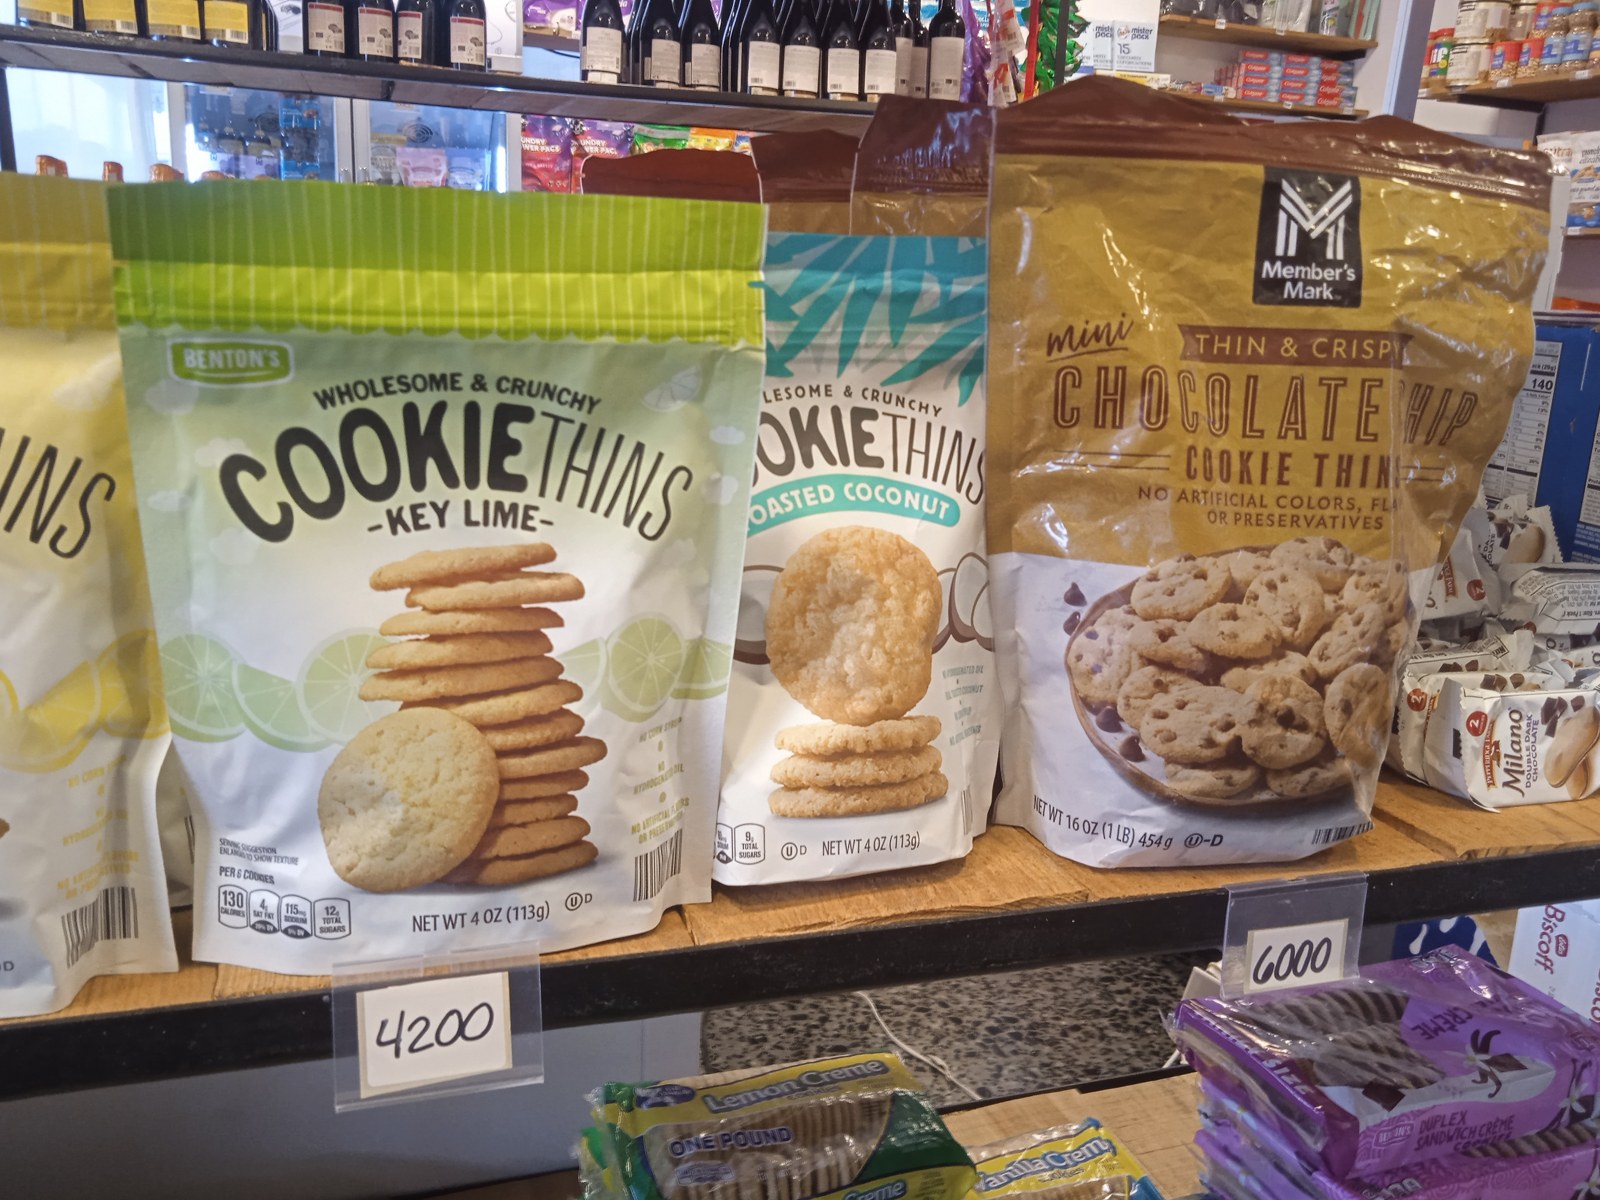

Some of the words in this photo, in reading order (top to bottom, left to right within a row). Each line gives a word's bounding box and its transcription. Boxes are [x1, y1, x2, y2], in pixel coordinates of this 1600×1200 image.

[1131, 26, 1153, 35] mister
[1118, 44, 1130, 54] 15
[1262, 260, 1356, 281] Member's
[1283, 281, 1333, 300] Mark
[1046, 312, 1134, 357] mini
[1196, 333, 1266, 356] THIN
[1281, 336, 1299, 358] &
[184, 347, 280, 369] BENTON'S
[313, 372, 463, 411] WHOLESOME
[471, 373, 488, 393] &
[495, 373, 602, 416] CRUNCHY
[1532, 378, 1554, 391] 140
[843, 385, 853, 398] &
[861, 387, 943, 418] CRUNCHY
[1053, 364, 1384, 443] CHOCOLATE
[1400, 379, 1478, 447] HIP
[1186, 445, 1292, 486] COOKIE
[843, 482, 950, 520] COCONUT
[1138, 486, 1168, 501] NO
[1177, 488, 1268, 509] ARTIFICIAL
[1276, 495, 1362, 513] COLORS,
[1207, 511, 1228, 525] OR
[1234, 512, 1384, 530] PRESERVATIVES
[1469, 719, 1480, 728] 2
[1525, 714, 1533, 743] DARK
[1502, 709, 1525, 798] Milano
[1531, 719, 1540, 782] CHOCOLATE
[1525, 744, 1533, 788] DOUBLE
[1033, 795, 1048, 817] NET
[1048, 804, 1062, 825] WT
[1066, 814, 1080, 832] 16
[1082, 820, 1099, 836] OZ
[1102, 821, 1113, 840] (1
[1116, 826, 1136, 848] LB)
[739, 851, 762, 859] SUGARS
[742, 843, 759, 851] TOTAL
[822, 840, 842, 856] NET
[844, 839, 861, 855] WT
[864, 839, 871, 851] 4
[873, 837, 887, 851] OZ
[889, 831, 921, 851] (113g)
[219, 866, 236, 878] PER
[254, 854, 273, 863] SHOW
[274, 855, 299, 866] TEXTURE
[220, 906, 246, 918] CALORIES
[222, 890, 244, 909] 130
[253, 910, 263, 919] SAT
[264, 911, 274, 920] FAT
[322, 917, 342, 925] TOTAL
[412, 914, 440, 932] NET
[443, 911, 468, 930] WT
[470, 911, 480, 925] 4
[484, 908, 503, 924] OZ
[506, 901, 550, 924] (113g)
[319, 925, 346, 934] SUGARS
[1535, 904, 1566, 975] Biscoff
[1253, 937, 1332, 985] 6000
[376, 1002, 494, 1059] 4200
[702, 1080, 798, 1113] Lemon
[799, 1058, 890, 1090] Creme
[1419, 1110, 1468, 1134] DUPLEX
[670, 1131, 716, 1158] ONE
[719, 1126, 794, 1150] POUND
[1414, 1126, 1478, 1151] SANDWICH
